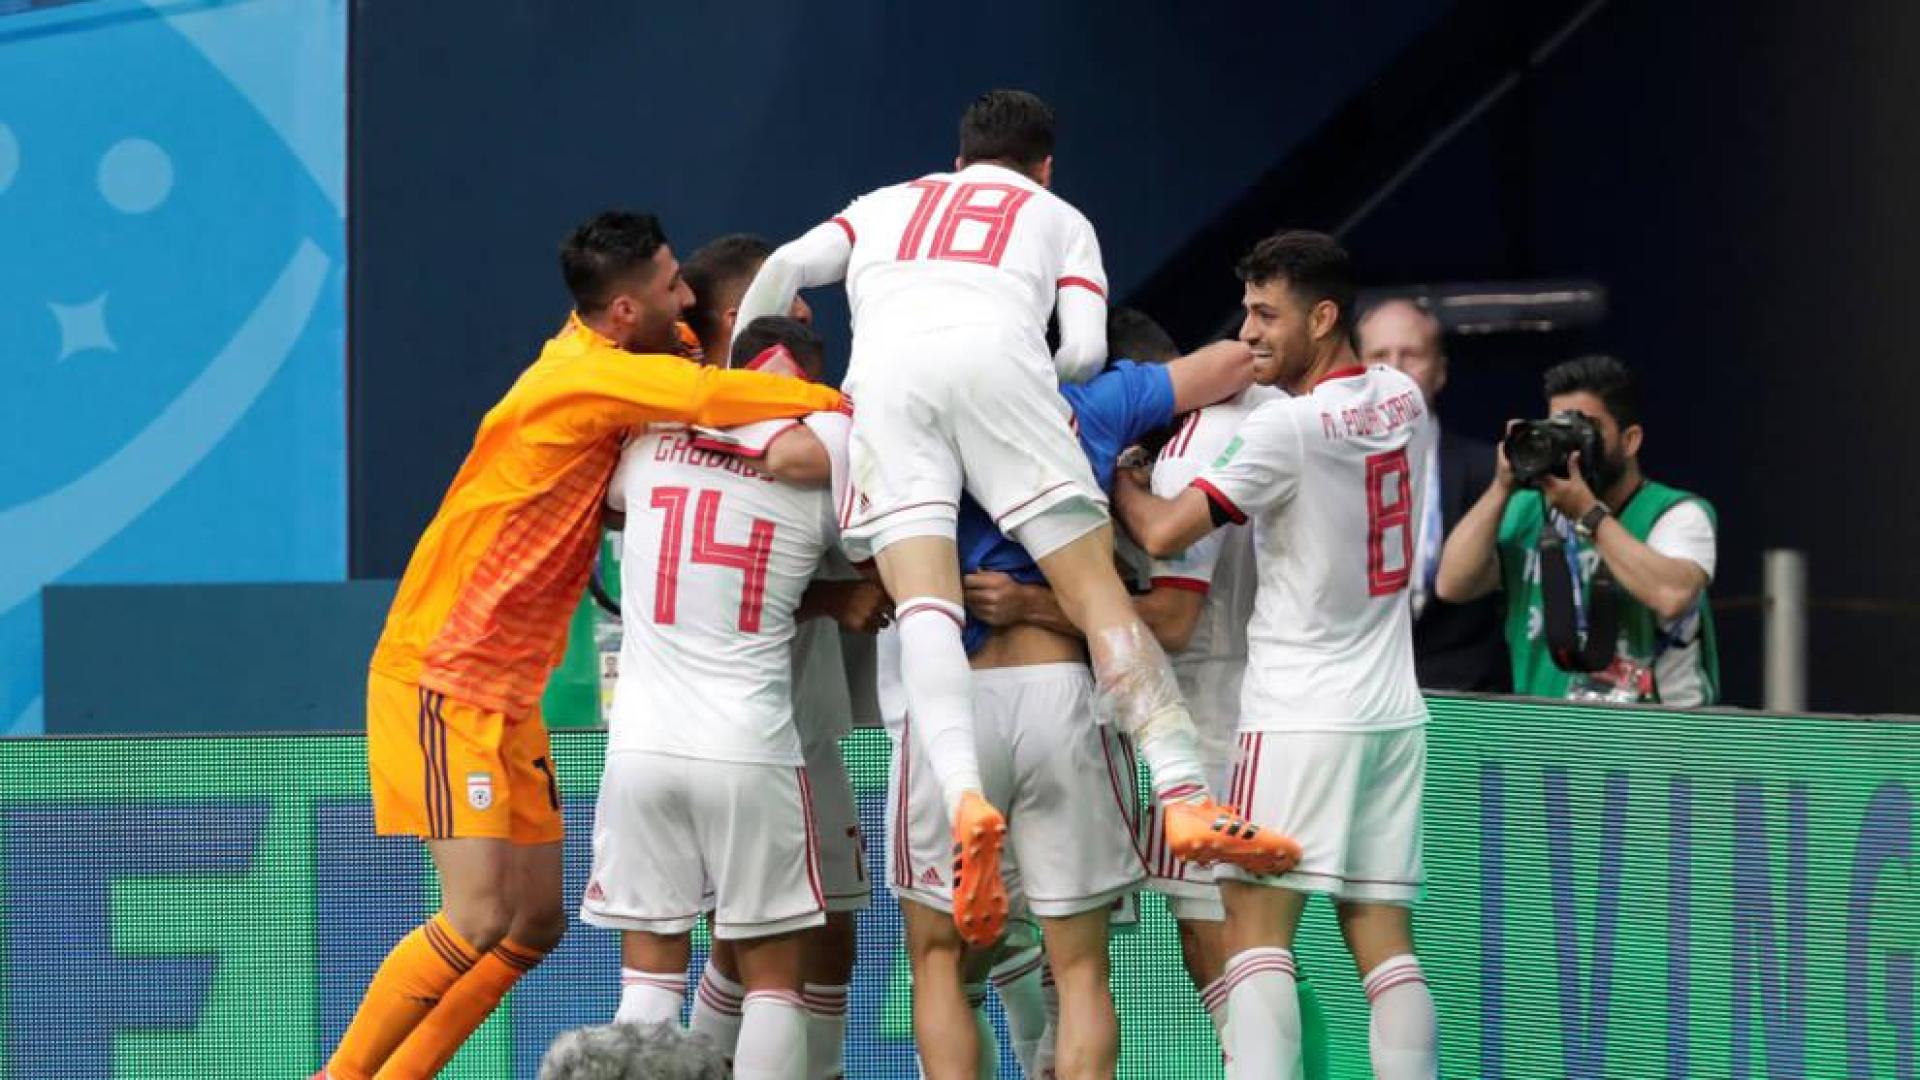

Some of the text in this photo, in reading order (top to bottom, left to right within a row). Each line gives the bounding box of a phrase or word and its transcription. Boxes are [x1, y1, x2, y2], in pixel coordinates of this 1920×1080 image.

[896, 180, 1034, 267] 18
[651, 486, 775, 632] 14
[1365, 448, 1413, 597] 8
